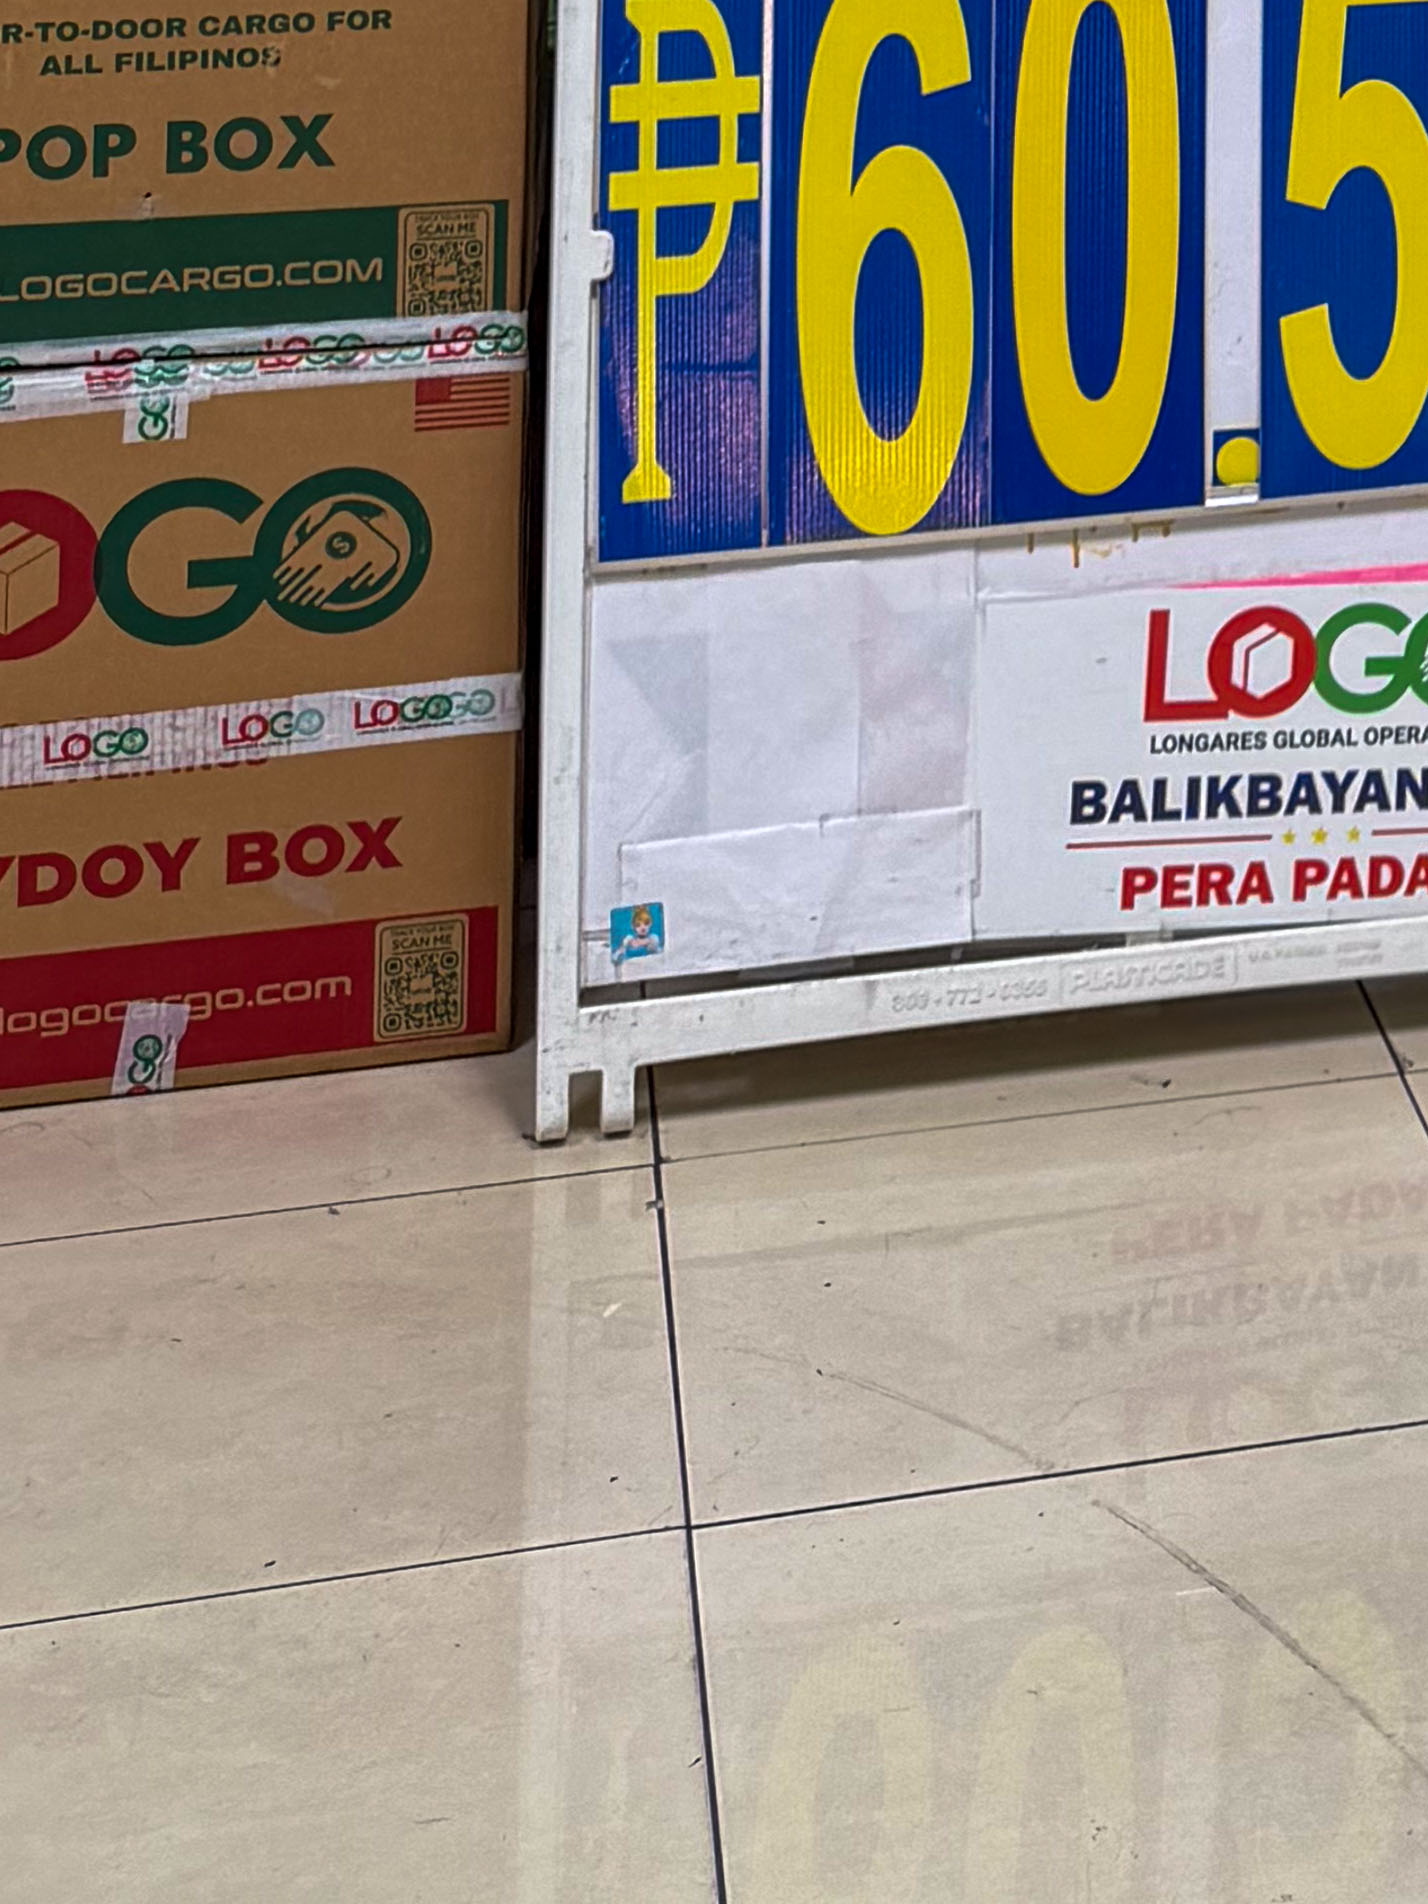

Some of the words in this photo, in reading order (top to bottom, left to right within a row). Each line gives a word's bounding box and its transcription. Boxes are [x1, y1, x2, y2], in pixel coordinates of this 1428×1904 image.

[0, 16, 187, 44] R-TO-DOOR
[198, 10, 316, 37] CARGO
[327, 9, 393, 32] FOR
[40, 51, 102, 76] ALL
[114, 46, 282, 73] FILIPINOS
[165, 113, 336, 174] BOX
[0, 466, 432, 661] OGO
[44, 727, 149, 764] LOGO
[221, 708, 324, 746] LOGO
[1149, 729, 1267, 754] LONGARES
[1272, 726, 1358, 750] GLOBAL
[0, 836, 200, 909] DOY
[225, 816, 403, 885] BOX
[1120, 861, 1275, 910] PERA
